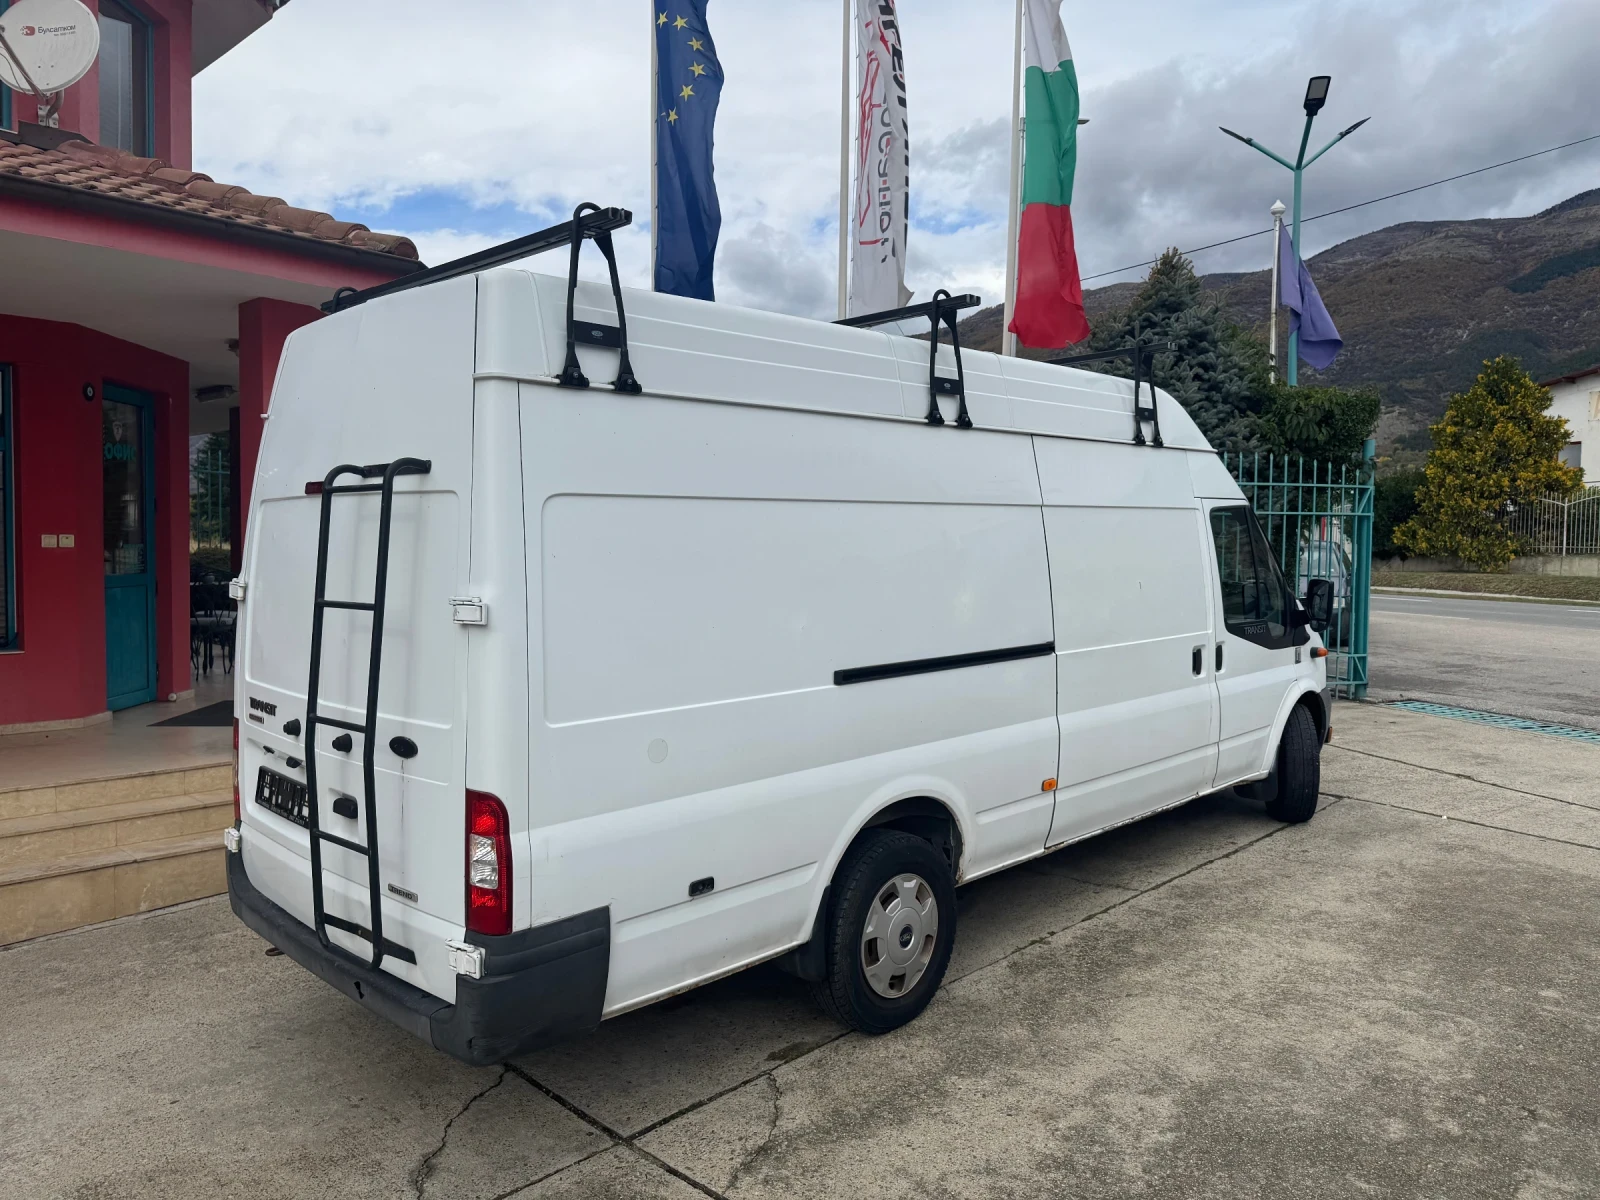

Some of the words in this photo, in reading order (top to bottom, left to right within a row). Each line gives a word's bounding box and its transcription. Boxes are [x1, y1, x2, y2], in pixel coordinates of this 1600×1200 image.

[38, 24, 76, 35] Булсатком
[1244, 625, 1266, 635] TRANSIT
[249, 697, 277, 717] TRANSIT
[391, 886, 413, 900] TREND
